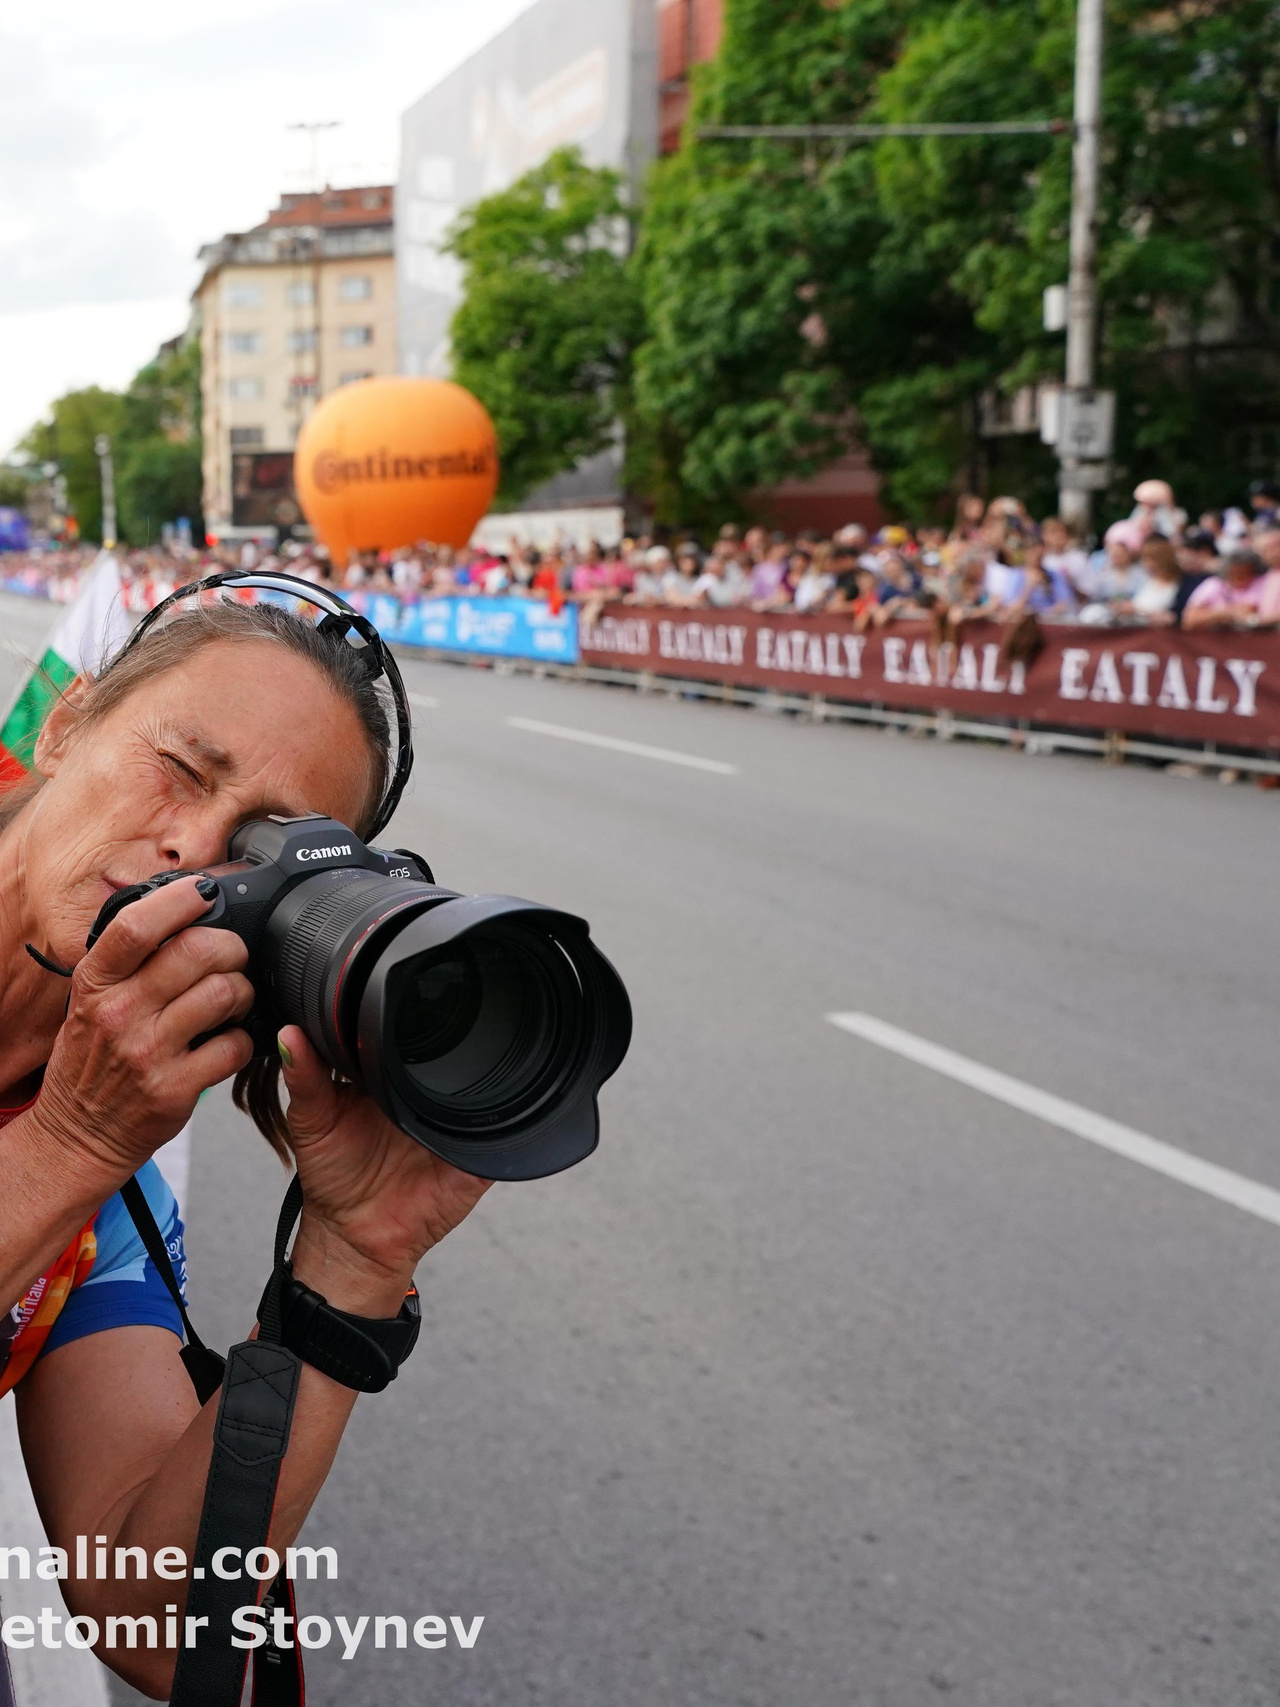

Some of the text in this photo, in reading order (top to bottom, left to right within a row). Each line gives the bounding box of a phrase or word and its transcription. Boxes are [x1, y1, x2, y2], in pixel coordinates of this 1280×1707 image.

[756, 628, 867, 679] EATALY
[1059, 648, 1267, 717] EATALY
[296, 845, 352, 861] Canon
[389, 867, 411, 879] EOS
